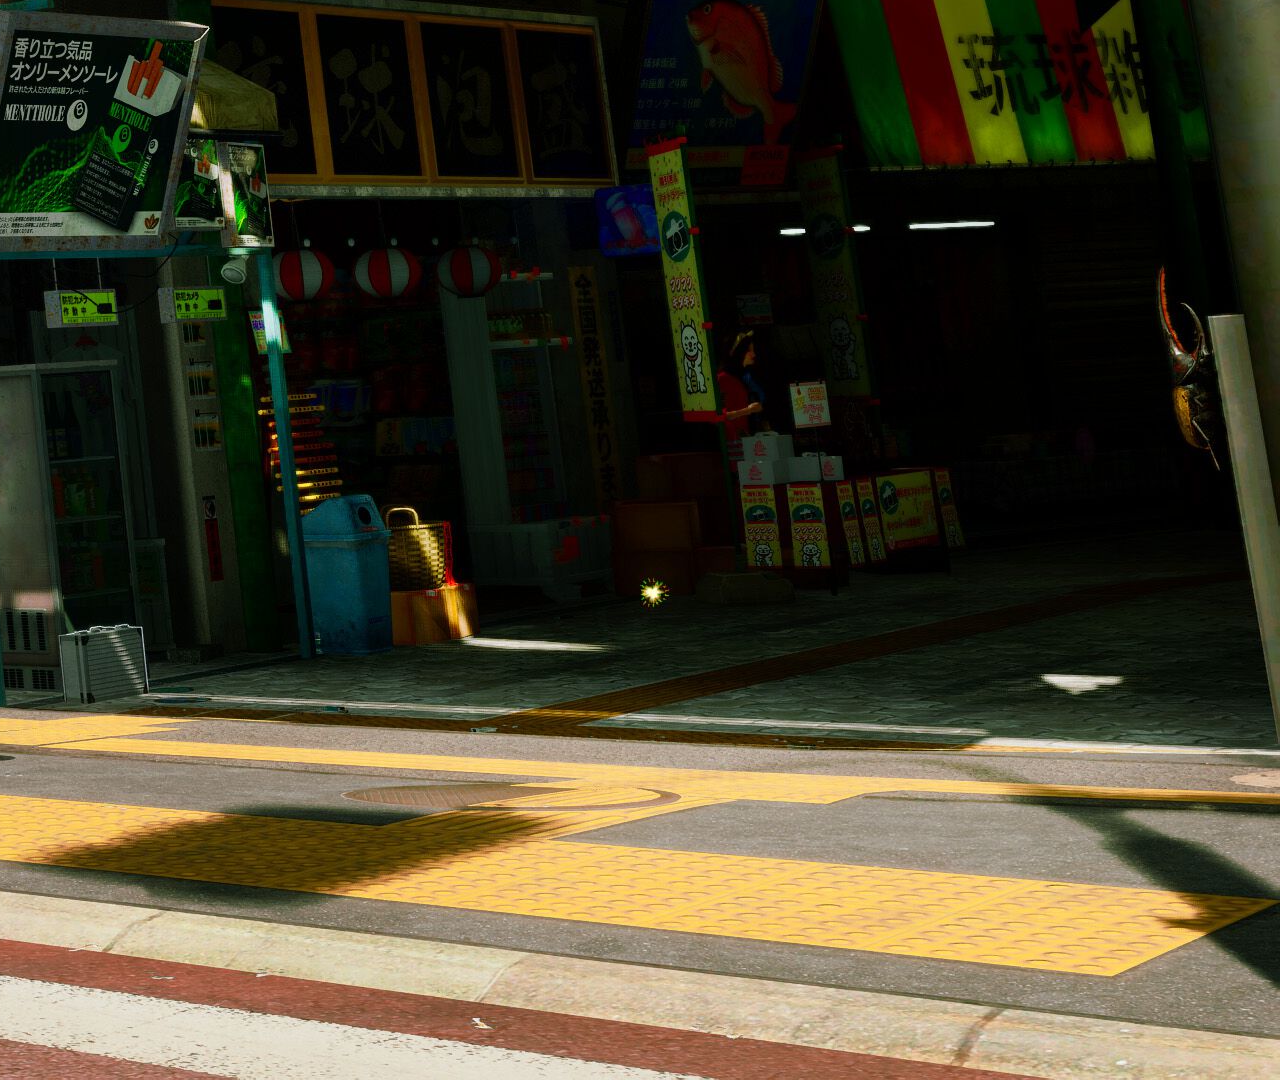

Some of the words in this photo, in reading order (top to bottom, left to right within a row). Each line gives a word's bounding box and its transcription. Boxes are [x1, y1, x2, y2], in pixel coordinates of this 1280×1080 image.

[15, 37, 93, 61] 香り立つ気品
[10, 61, 119, 84] オンリーメンソーレ
